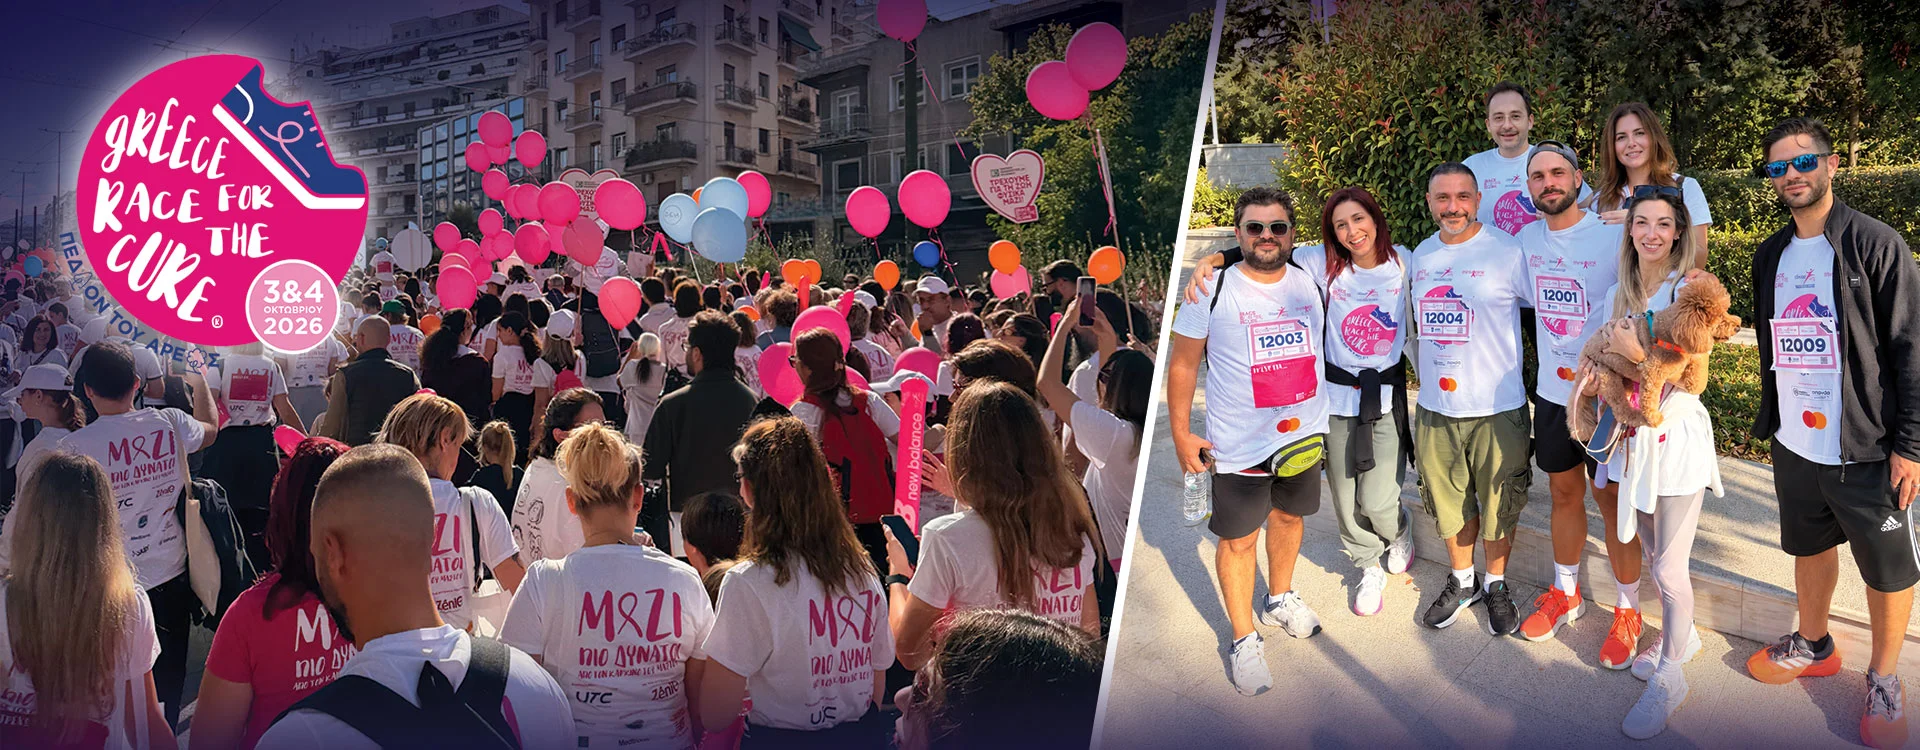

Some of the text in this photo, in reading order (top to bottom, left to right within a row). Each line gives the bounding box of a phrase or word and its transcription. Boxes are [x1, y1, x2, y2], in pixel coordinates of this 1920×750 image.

[1543, 289, 1578, 303] 12001
[1425, 312, 1463, 324] 12004
[1258, 331, 1304, 349] 12003
[1780, 337, 1826, 353] 12009
[907, 412, 922, 501] new balance
[117, 497, 134, 510] TC
[431, 512, 460, 556] ΖΙ
[1881, 522, 1902, 531] adidas
[431, 557, 463, 574] ΑΤΟΙ
[579, 647, 609, 667] ΠΙΟ
[811, 646, 872, 676] ΠΙΟ ΔΥΝΑ
[295, 656, 326, 678] ΠΙΟ
[576, 691, 613, 704] UTC
